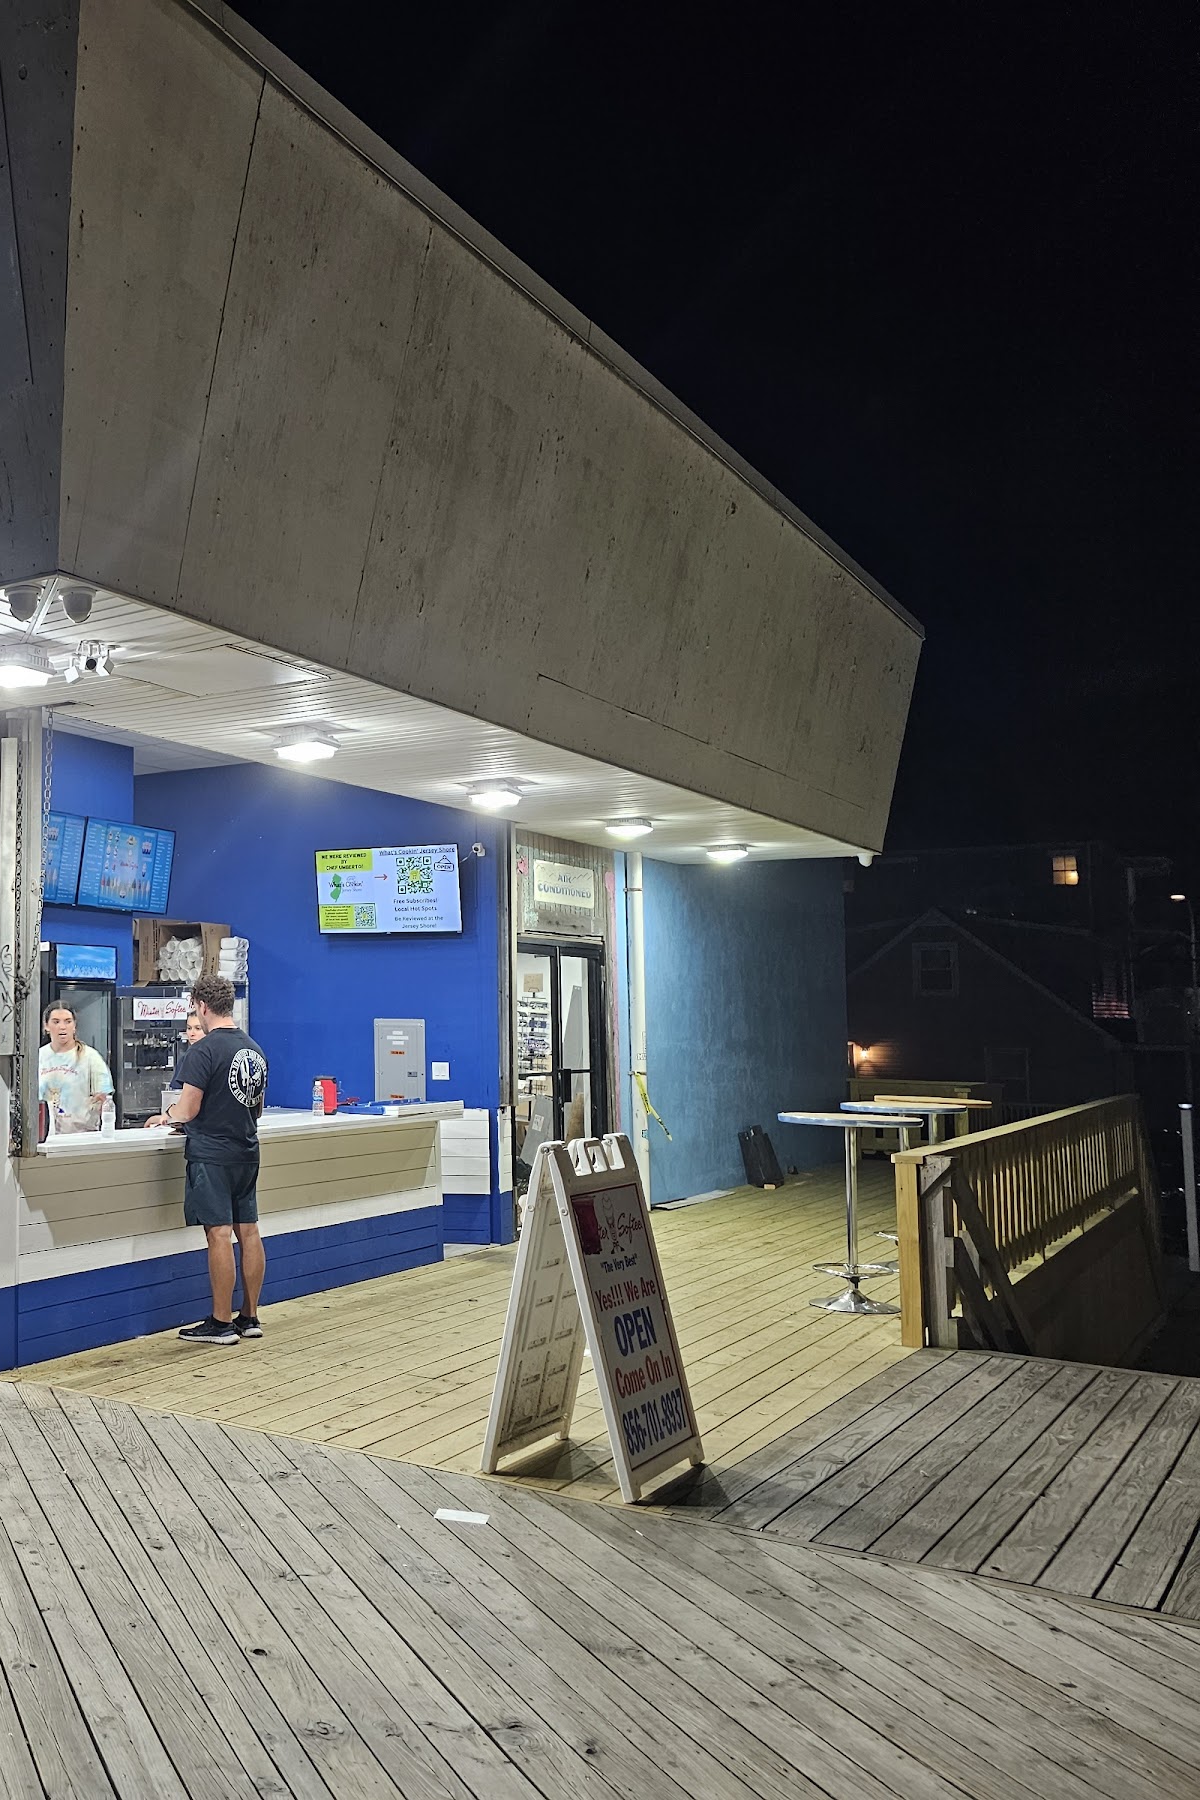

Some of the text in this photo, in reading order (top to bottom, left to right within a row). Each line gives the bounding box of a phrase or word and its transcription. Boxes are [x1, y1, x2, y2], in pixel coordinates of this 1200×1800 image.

[537, 883, 591, 899] CONDITIONED
[558, 874, 572, 883] AIR
[613, 1258, 625, 1271] Very
[595, 1276, 656, 1312] Yes!!! We Are
[613, 1306, 658, 1357] OPEN
[615, 1350, 674, 1399] Come On In
[622, 1387, 687, 1456] 856-701-8937
